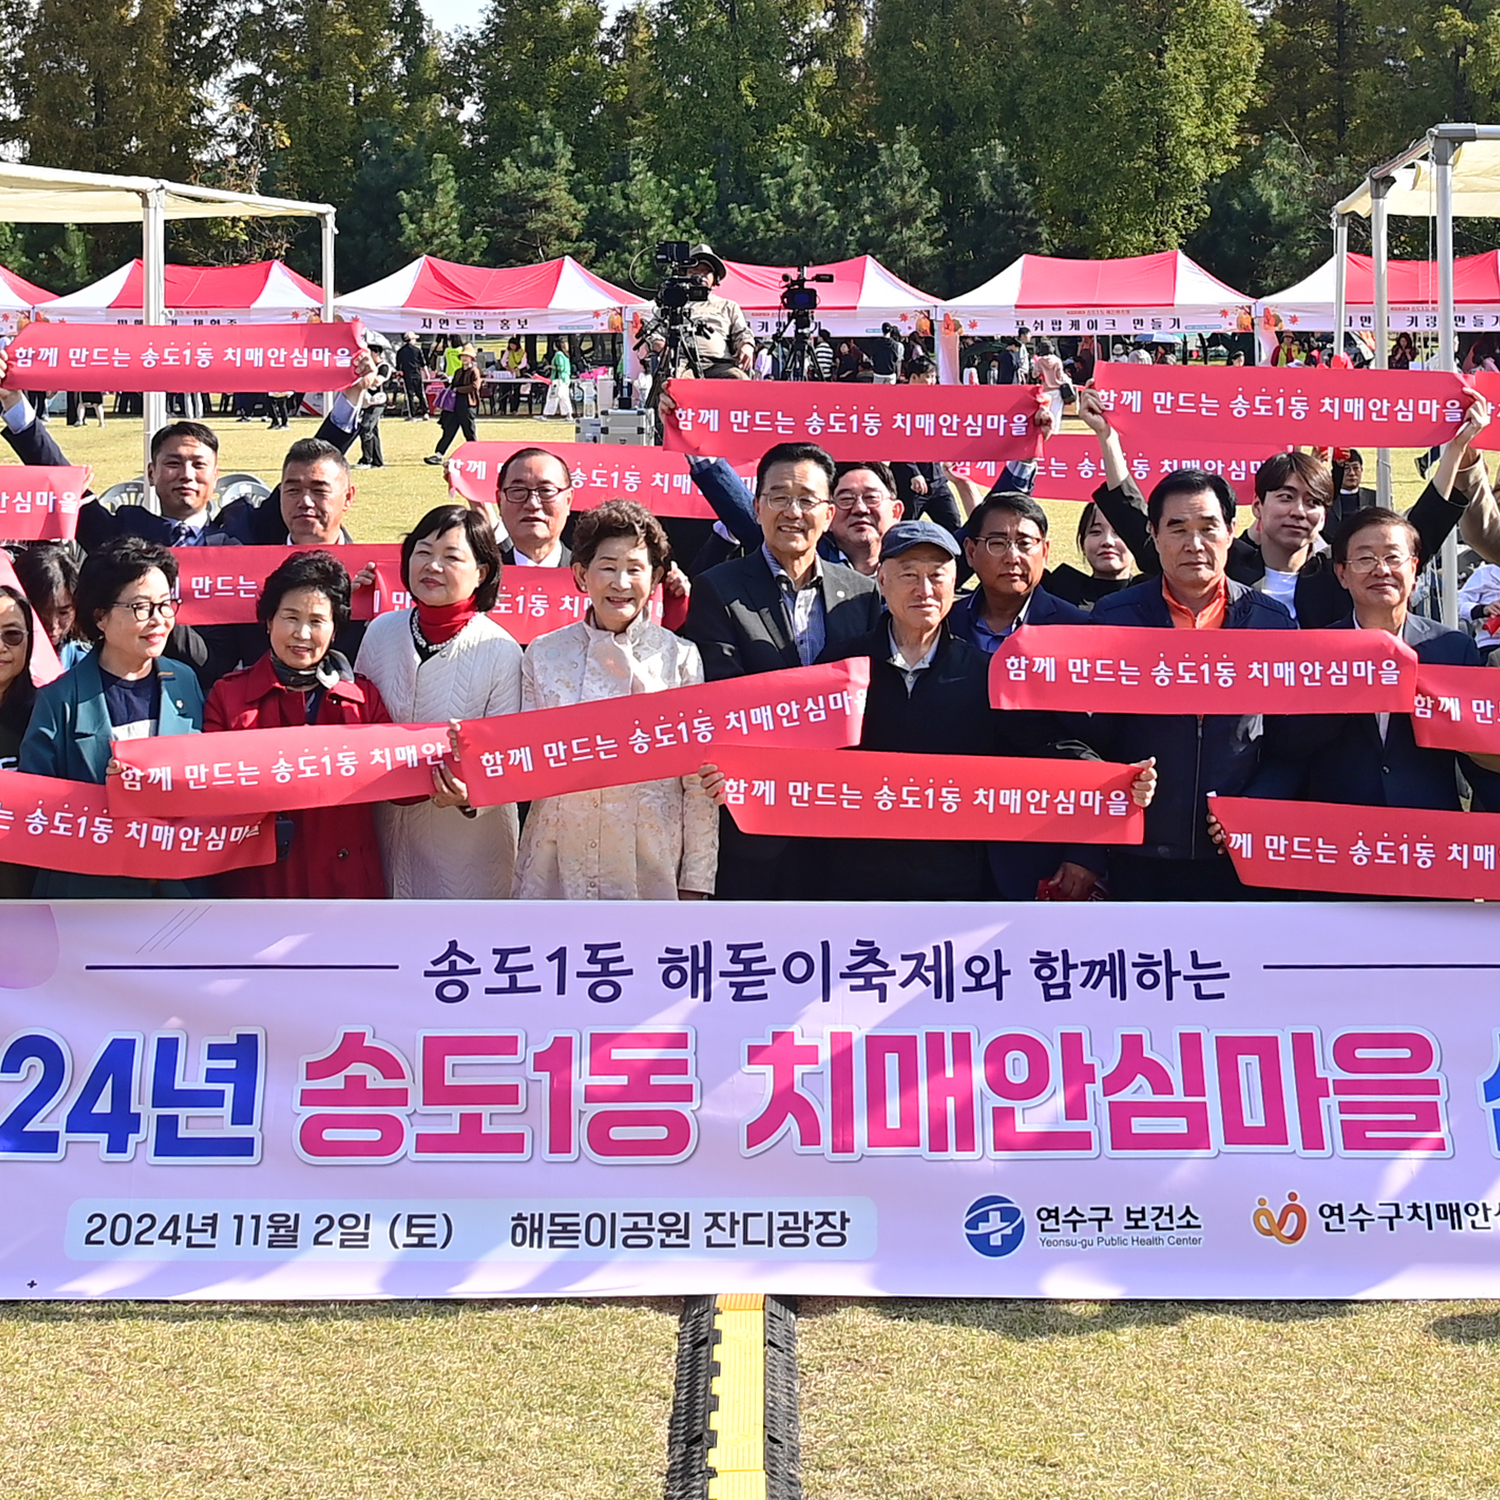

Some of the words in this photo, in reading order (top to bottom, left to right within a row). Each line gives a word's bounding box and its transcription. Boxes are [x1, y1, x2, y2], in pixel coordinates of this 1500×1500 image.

[1132, 317, 1181, 331] 만들기
[1406, 315, 1437, 328] 키링
[15, 347, 58, 367] 함께
[68, 347, 131, 367] 만드는
[139, 347, 213, 368] 송도1동
[222, 347, 352, 367] 치매안심마을
[1099, 389, 1141, 412] 함께
[1153, 391, 1219, 416] 만드는
[1229, 394, 1309, 420] 송도1동
[1319, 396, 1462, 422] 치매안심마을
[675, 408, 718, 431] 함께
[730, 410, 795, 434] 만드는
[804, 412, 882, 436] 송도1동
[892, 413, 1028, 436] 치매안심마을
[568, 467, 642, 492] 송도1동
[1035, 457, 1068, 477] 드는
[1076, 455, 1150, 480] 송동
[1159, 459, 1265, 482] 치매안심
[191, 575, 257, 598] 만드는
[492, 592, 549, 617] 도1동
[1005, 656, 1055, 681] 함께
[1068, 658, 1140, 685] 만드는
[1150, 660, 1236, 687] 송도1동
[1247, 659, 1400, 686] 치매안심마을
[1414, 694, 1461, 721] 함께
[480, 746, 533, 777] 함께
[543, 734, 618, 767] 만드는
[628, 716, 715, 754] 송도1동
[120, 759, 172, 791] 함께
[184, 760, 260, 789] 만드는
[270, 751, 358, 783] 송도1동
[367, 737, 451, 771] 치매안
[724, 778, 775, 805] 함께
[788, 781, 862, 808] 만드는
[873, 785, 961, 813] 송도1동
[972, 788, 1128, 815] 치매안심마을
[24, 807, 113, 844] 송도1동
[124, 821, 259, 851] 치매안심마
[1228, 833, 1252, 858] 께
[1265, 835, 1338, 863] 만드는
[1348, 840, 1435, 868] 송도1동
[423, 939, 634, 1004] 송도1동
[657, 939, 1011, 1003] 해돋이축제와
[1029, 948, 1230, 1002] 함께하는
[300, 1032, 694, 1157] 송도1동
[747, 1031, 1447, 1154] 치매안심마을
[84, 1212, 219, 1249] 2024년
[233, 1213, 300, 1249] 11월
[313, 1213, 371, 1249] 2일
[389, 1213, 453, 1249] (토)
[511, 1212, 690, 1249] 해돋이공원
[704, 1210, 851, 1248] 잔디광장
[1036, 1206, 1113, 1233] 연수구
[1124, 1205, 1202, 1232] 보건소
[1039, 1237, 1094, 1249] Yeonsu-gu
[1097, 1236, 1128, 1247] Public
[1131, 1236, 1165, 1246] Health
[1168, 1236, 1202, 1246] Center
